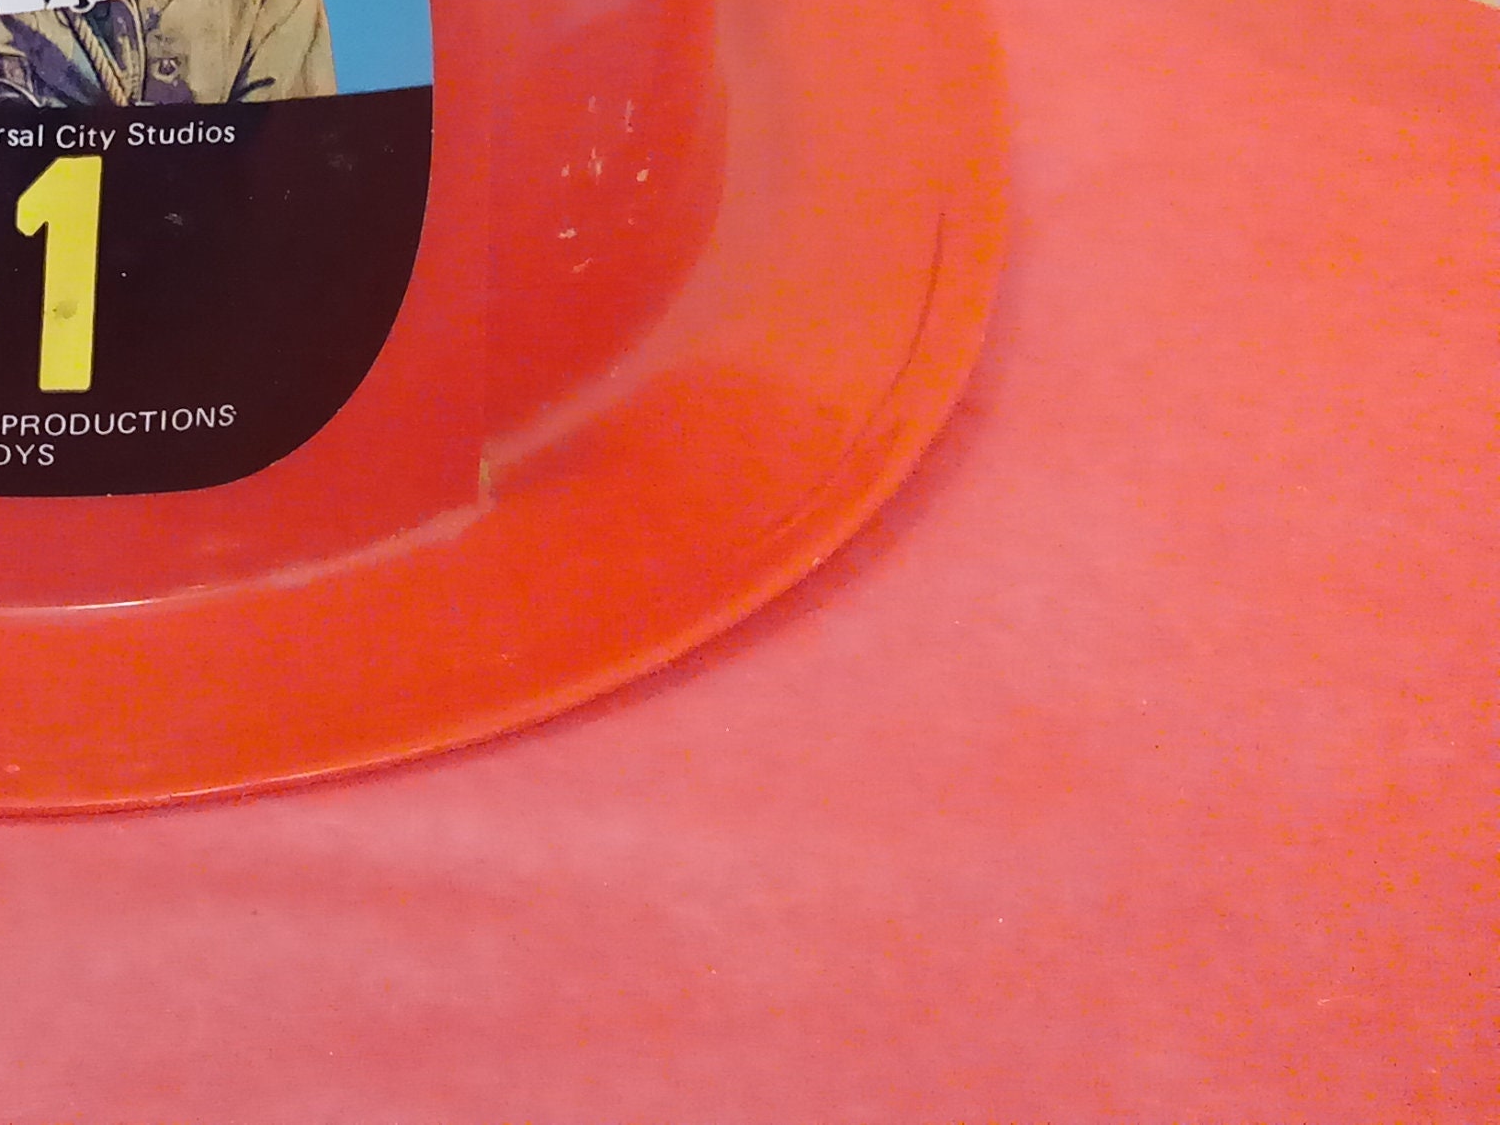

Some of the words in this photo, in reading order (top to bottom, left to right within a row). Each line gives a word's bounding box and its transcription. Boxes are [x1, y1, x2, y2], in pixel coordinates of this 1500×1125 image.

[56, 123, 115, 150] City
[128, 121, 236, 146] Studios
[1, 404, 236, 436] PRODUCTIONS
